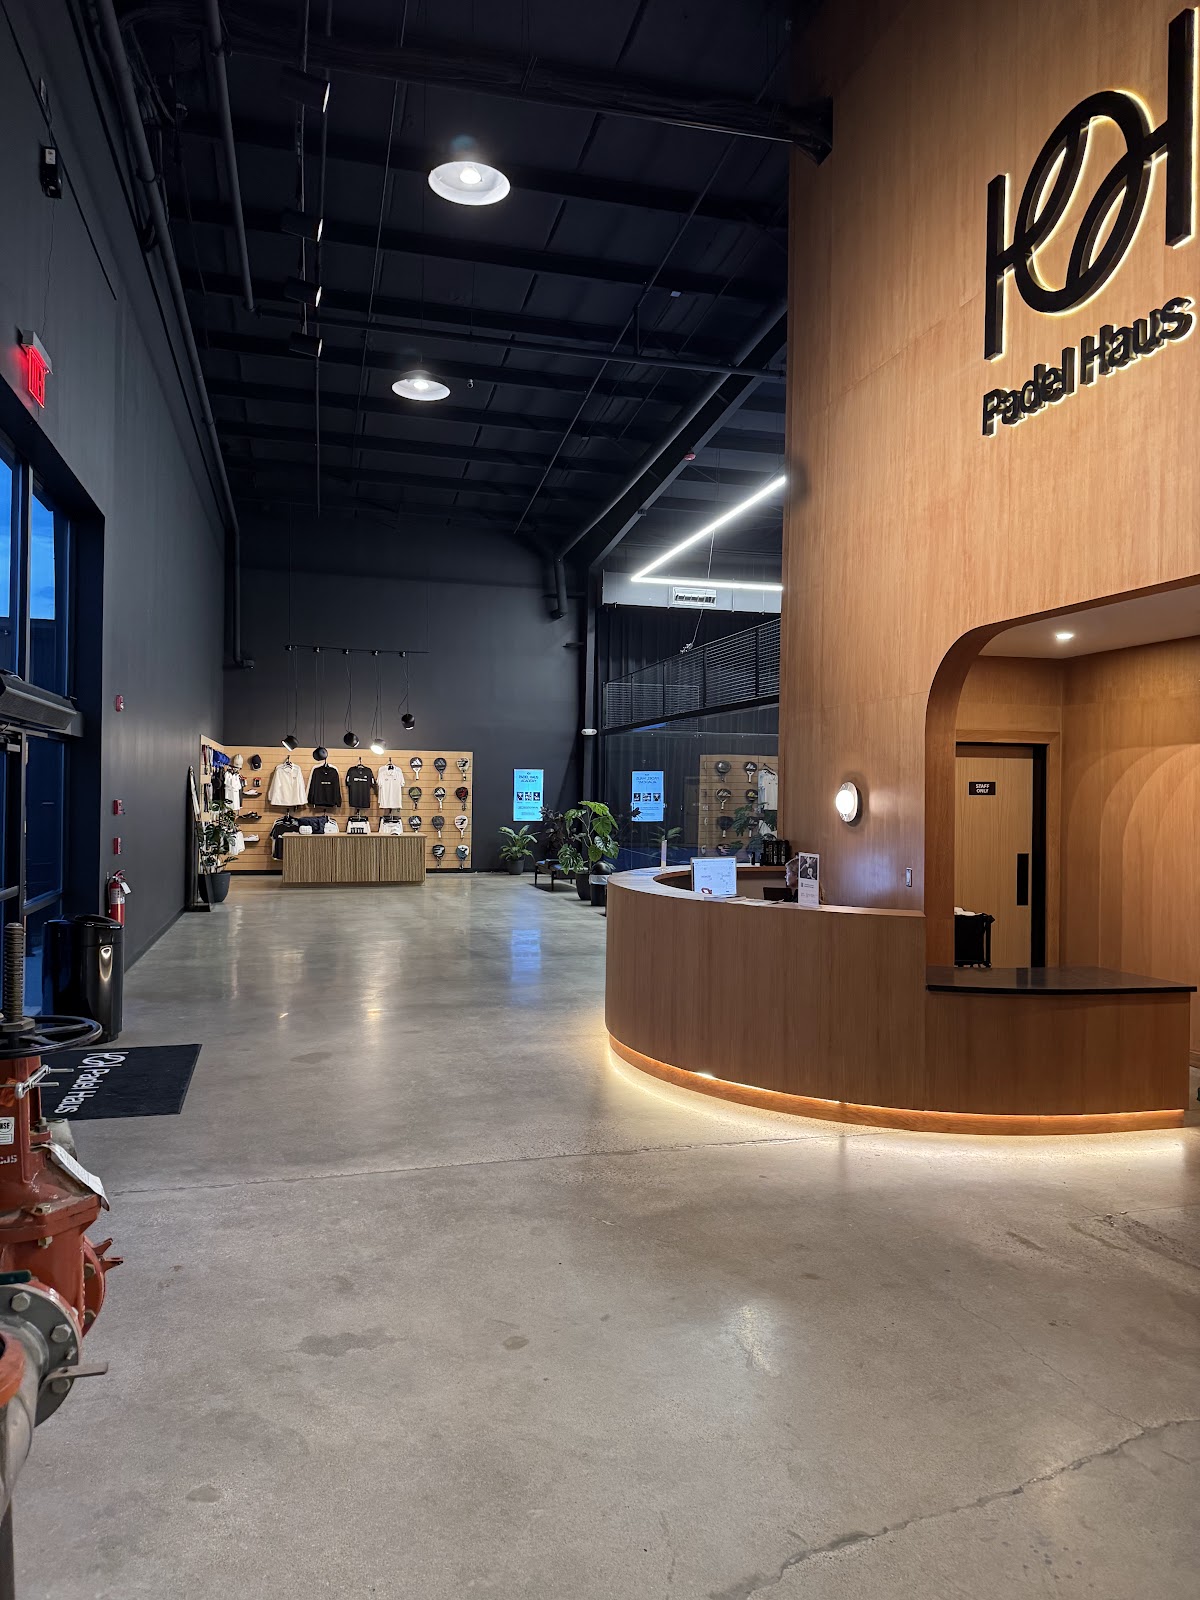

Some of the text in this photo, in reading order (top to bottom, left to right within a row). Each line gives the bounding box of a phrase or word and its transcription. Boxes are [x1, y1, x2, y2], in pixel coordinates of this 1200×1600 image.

[982, 297, 1194, 437] Padel Haus
[71, 1068, 110, 1089] Padel
[54, 1090, 96, 1114] Haus
